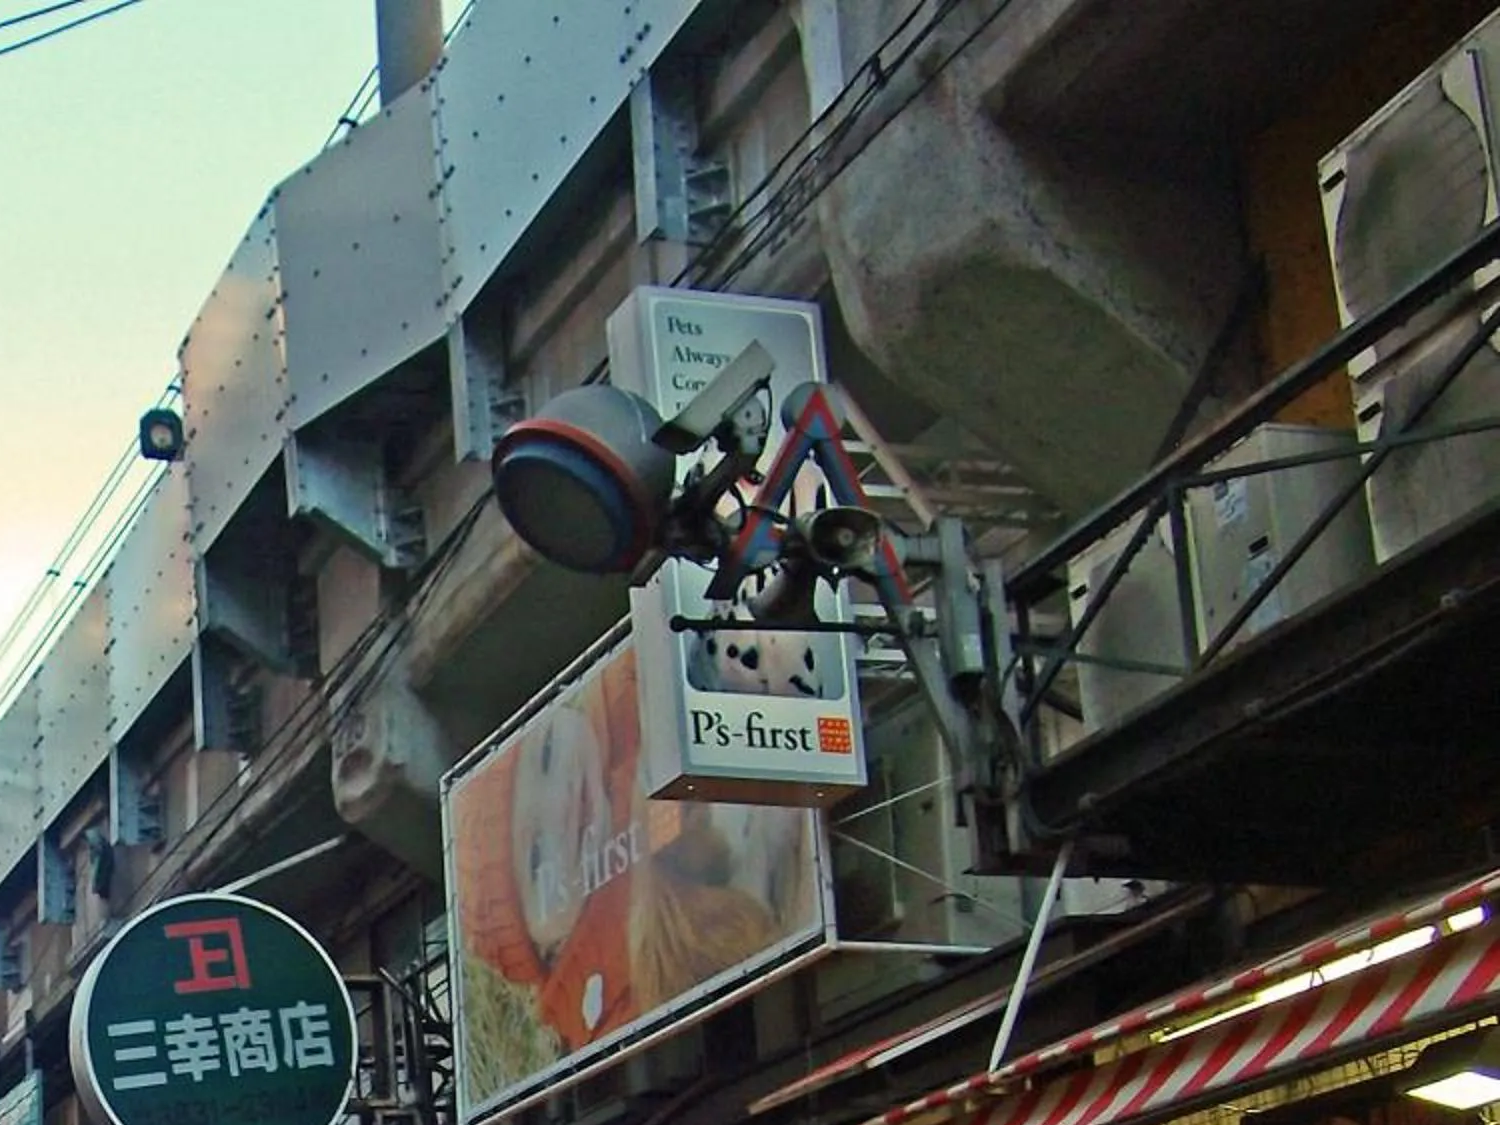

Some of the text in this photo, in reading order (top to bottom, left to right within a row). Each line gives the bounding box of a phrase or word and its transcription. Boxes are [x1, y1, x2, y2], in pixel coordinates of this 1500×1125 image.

[667, 316, 703, 336] Pets
[690, 709, 814, 752] P's-first
[107, 1000, 335, 1091] 三幸商店
